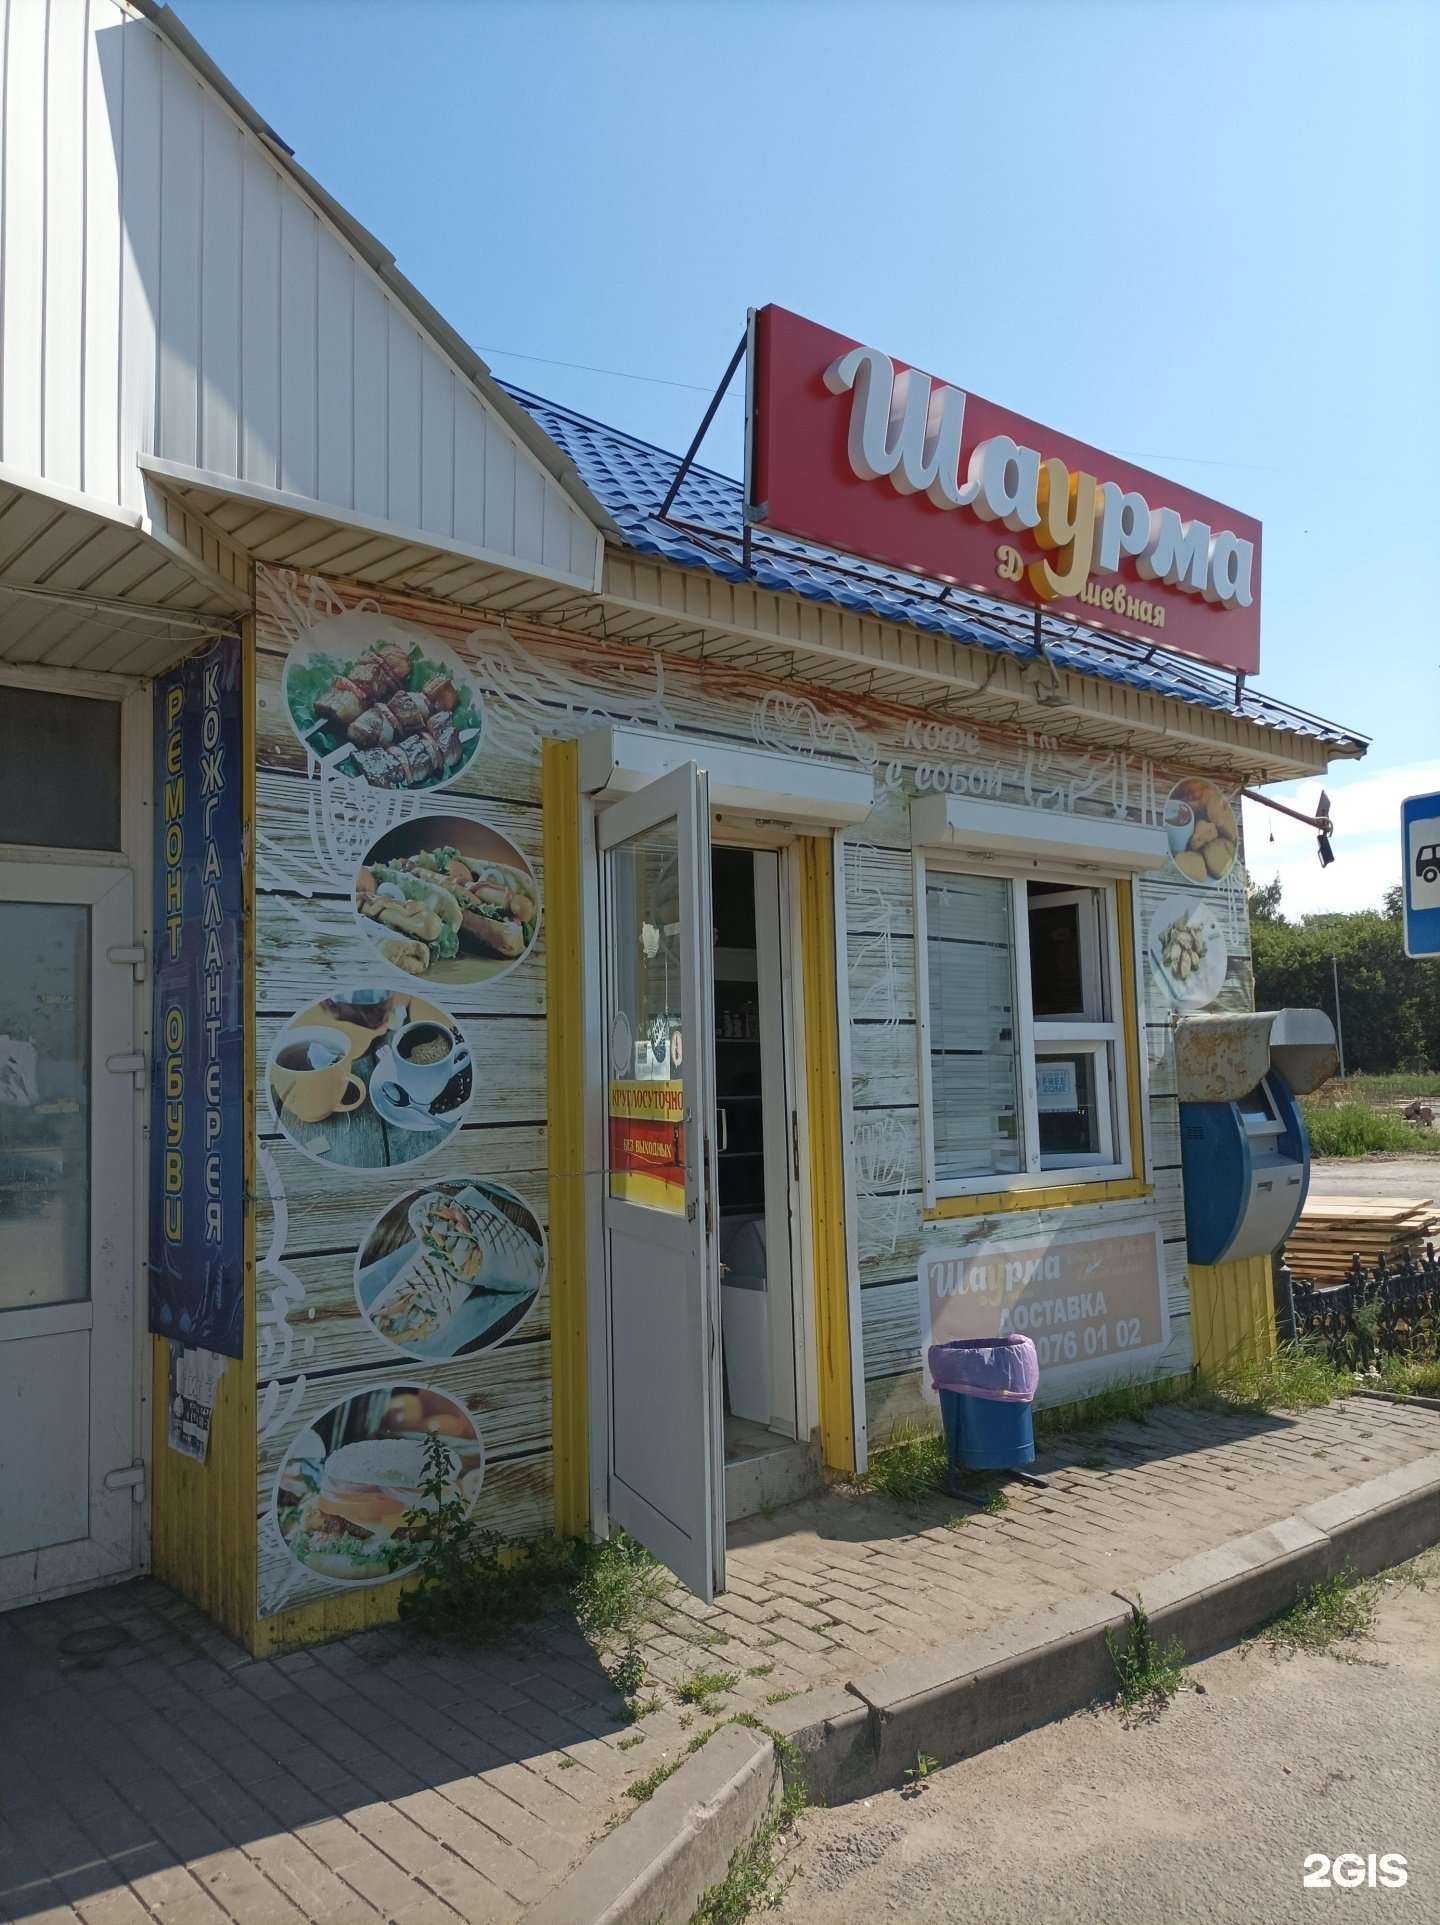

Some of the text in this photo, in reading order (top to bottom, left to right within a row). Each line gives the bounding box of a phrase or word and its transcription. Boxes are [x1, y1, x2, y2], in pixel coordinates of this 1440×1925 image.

[823, 347, 1253, 607] Шаурма
[164, 687, 185, 1243] РЕМОНТ ОБУВИ
[200, 663, 224, 1244] КОЖГАЛАНТЕРЕЯ
[611, 1089, 683, 1111] КРУГЛОСУТОЧНО
[623, 1138, 672, 1159] БЕЗ ВЫХОДНЫХ
[1083, 1324, 1108, 1356] 01
[1116, 1318, 1141, 1348] 02
